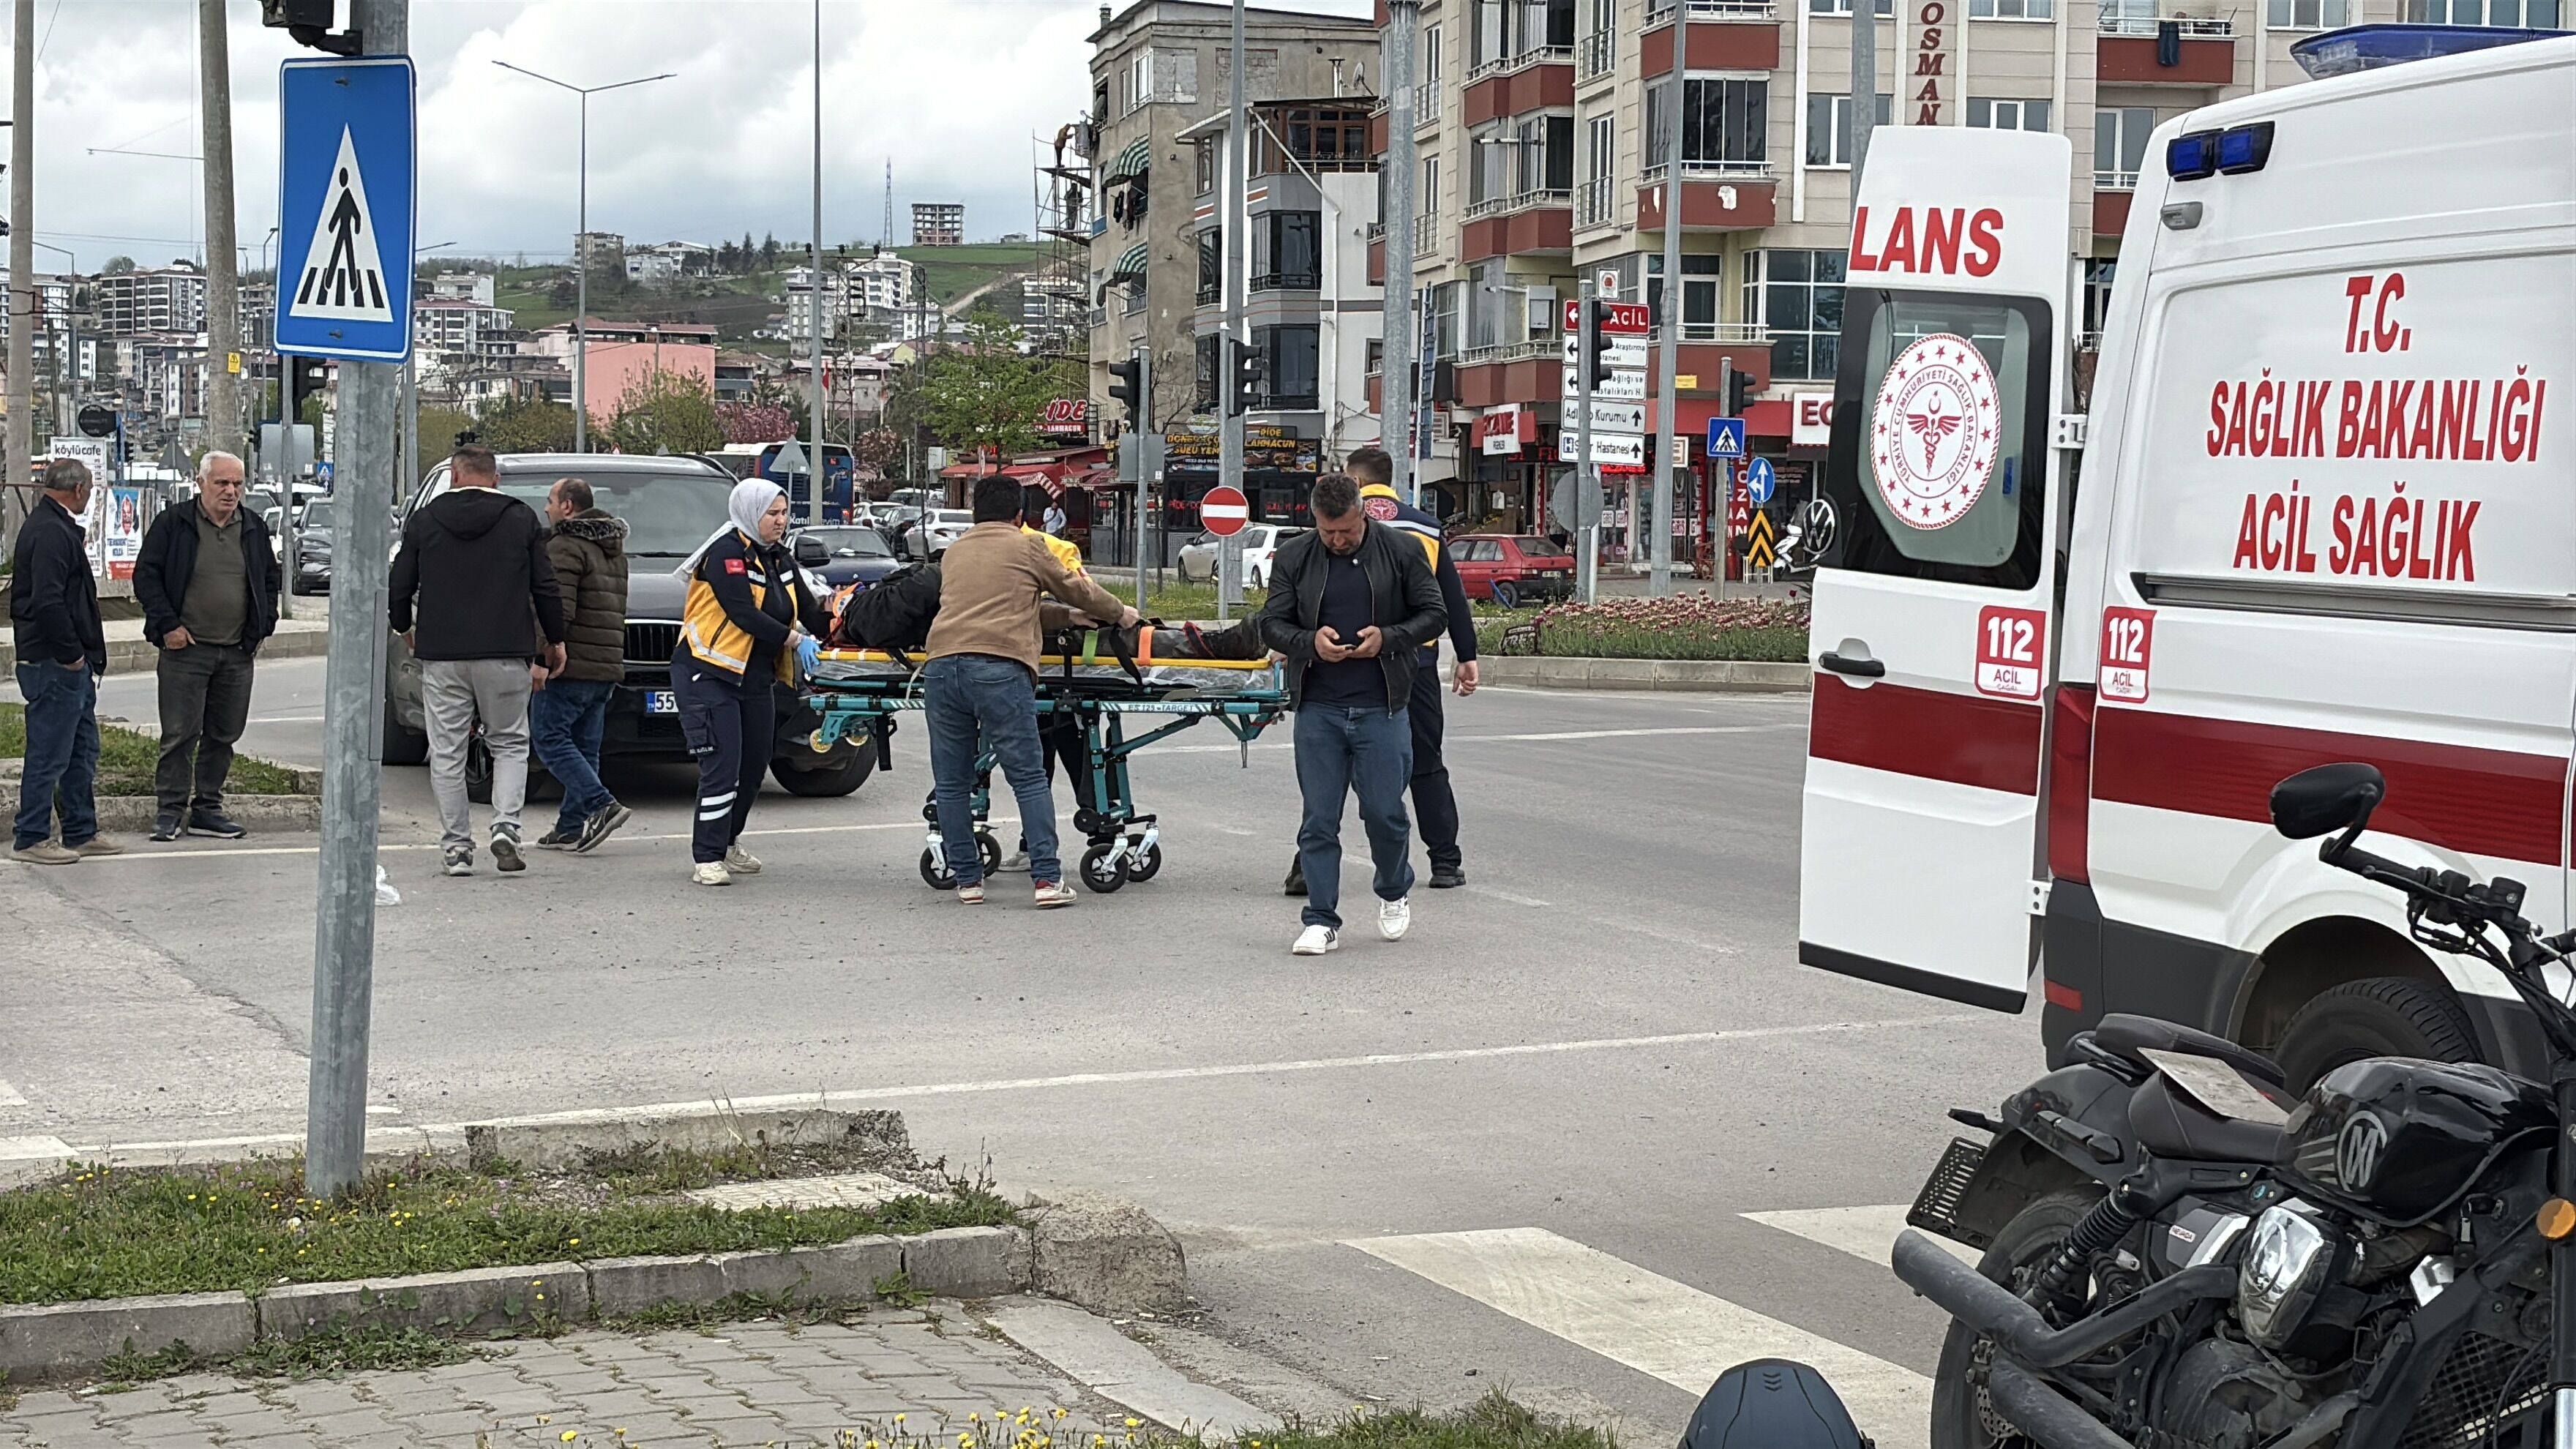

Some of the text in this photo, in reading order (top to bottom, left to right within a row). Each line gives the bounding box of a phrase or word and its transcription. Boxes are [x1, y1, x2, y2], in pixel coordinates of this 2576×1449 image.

[1914, 1, 1944, 125] OSMAN
[1849, 206, 2004, 277] LANS
[1610, 308, 1647, 326] ACİL
[2345, 273, 2411, 353] T.C.
[1947, 374, 1972, 413] SAĞLIK
[1595, 409, 1627, 422] Kurumu
[2206, 364, 2546, 463] SAĞLIK BAKANLIĞI
[1261, 427, 1282, 437] PİDE
[1244, 439, 1296, 448] LAHMACUN
[1596, 441, 1630, 454] Hastanesi
[2233, 479, 2482, 582] ACİL SAĞLIK
[1988, 616, 2034, 662] 112
[2109, 617, 2144, 663] 112
[1993, 667, 2022, 685] ACİL
[2112, 670, 2134, 687] ACİL
[656, 694, 675, 711] 55
[1162, 705, 1194, 713] TARGET
